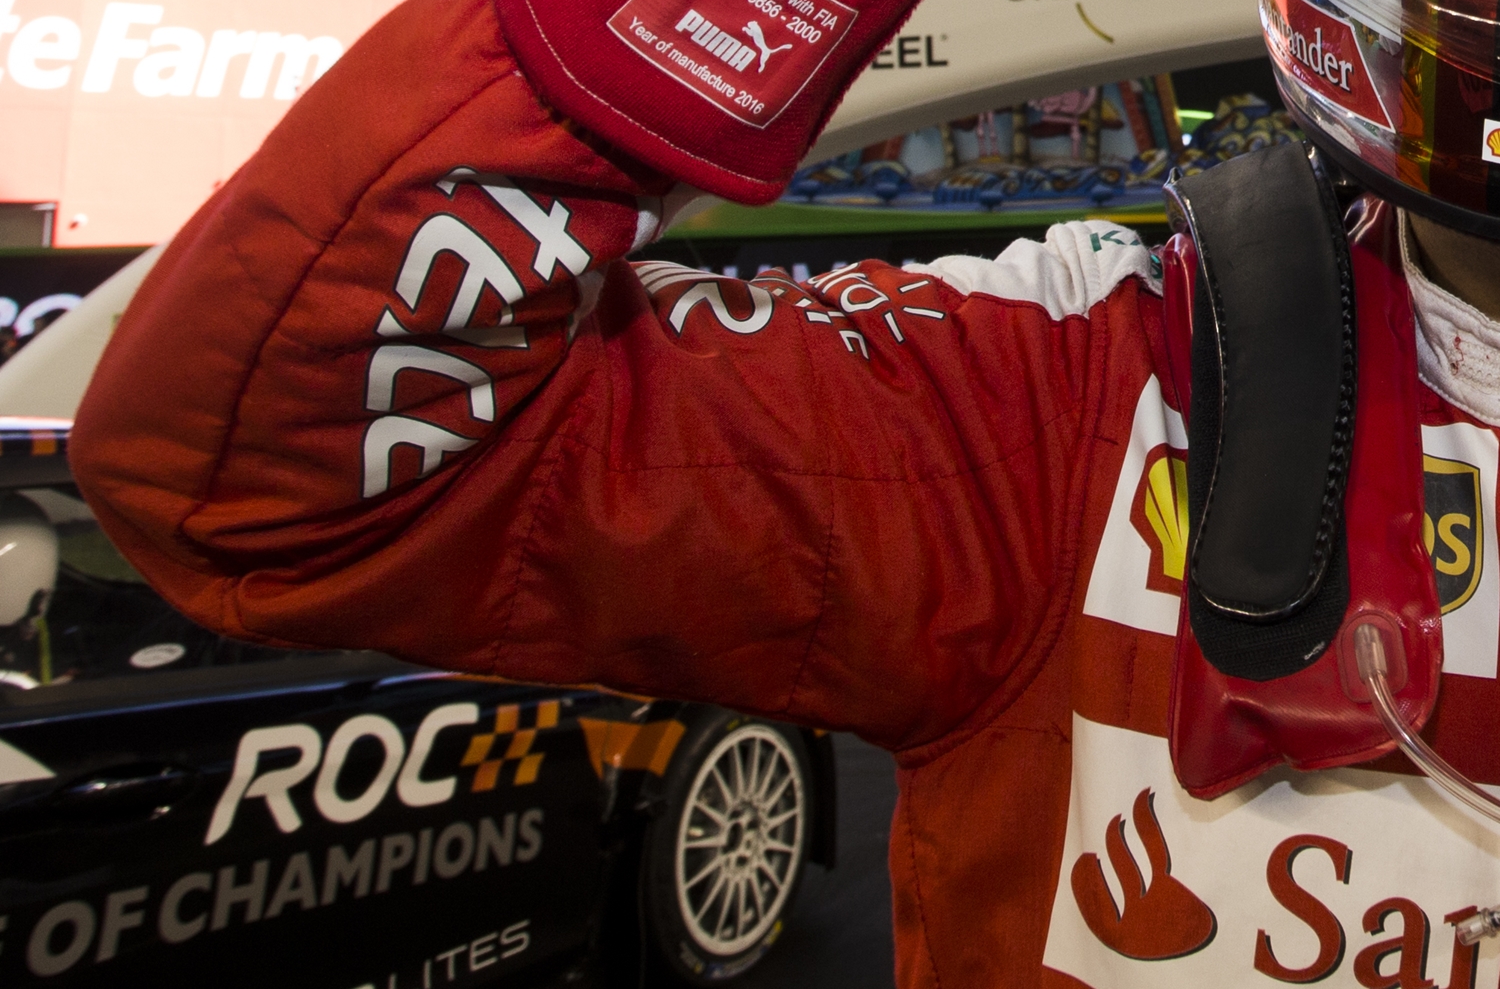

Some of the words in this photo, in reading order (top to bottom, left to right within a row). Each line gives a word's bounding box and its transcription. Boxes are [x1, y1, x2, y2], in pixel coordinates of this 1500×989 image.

[80, 1, 345, 100] Farm
[674, 8, 758, 73] PUMA
[786, 15, 823, 45] 2000
[812, 8, 839, 31] FIA
[870, 34, 949, 69] EEL
[627, 15, 660, 45] Year
[655, 38, 673, 54] of
[667, 48, 737, 99] manufacture
[734, 90, 766, 116] 2016
[204, 702, 480, 847] ROC
[25, 885, 151, 979] OF
[156, 809, 546, 945] CHAMPIONS
